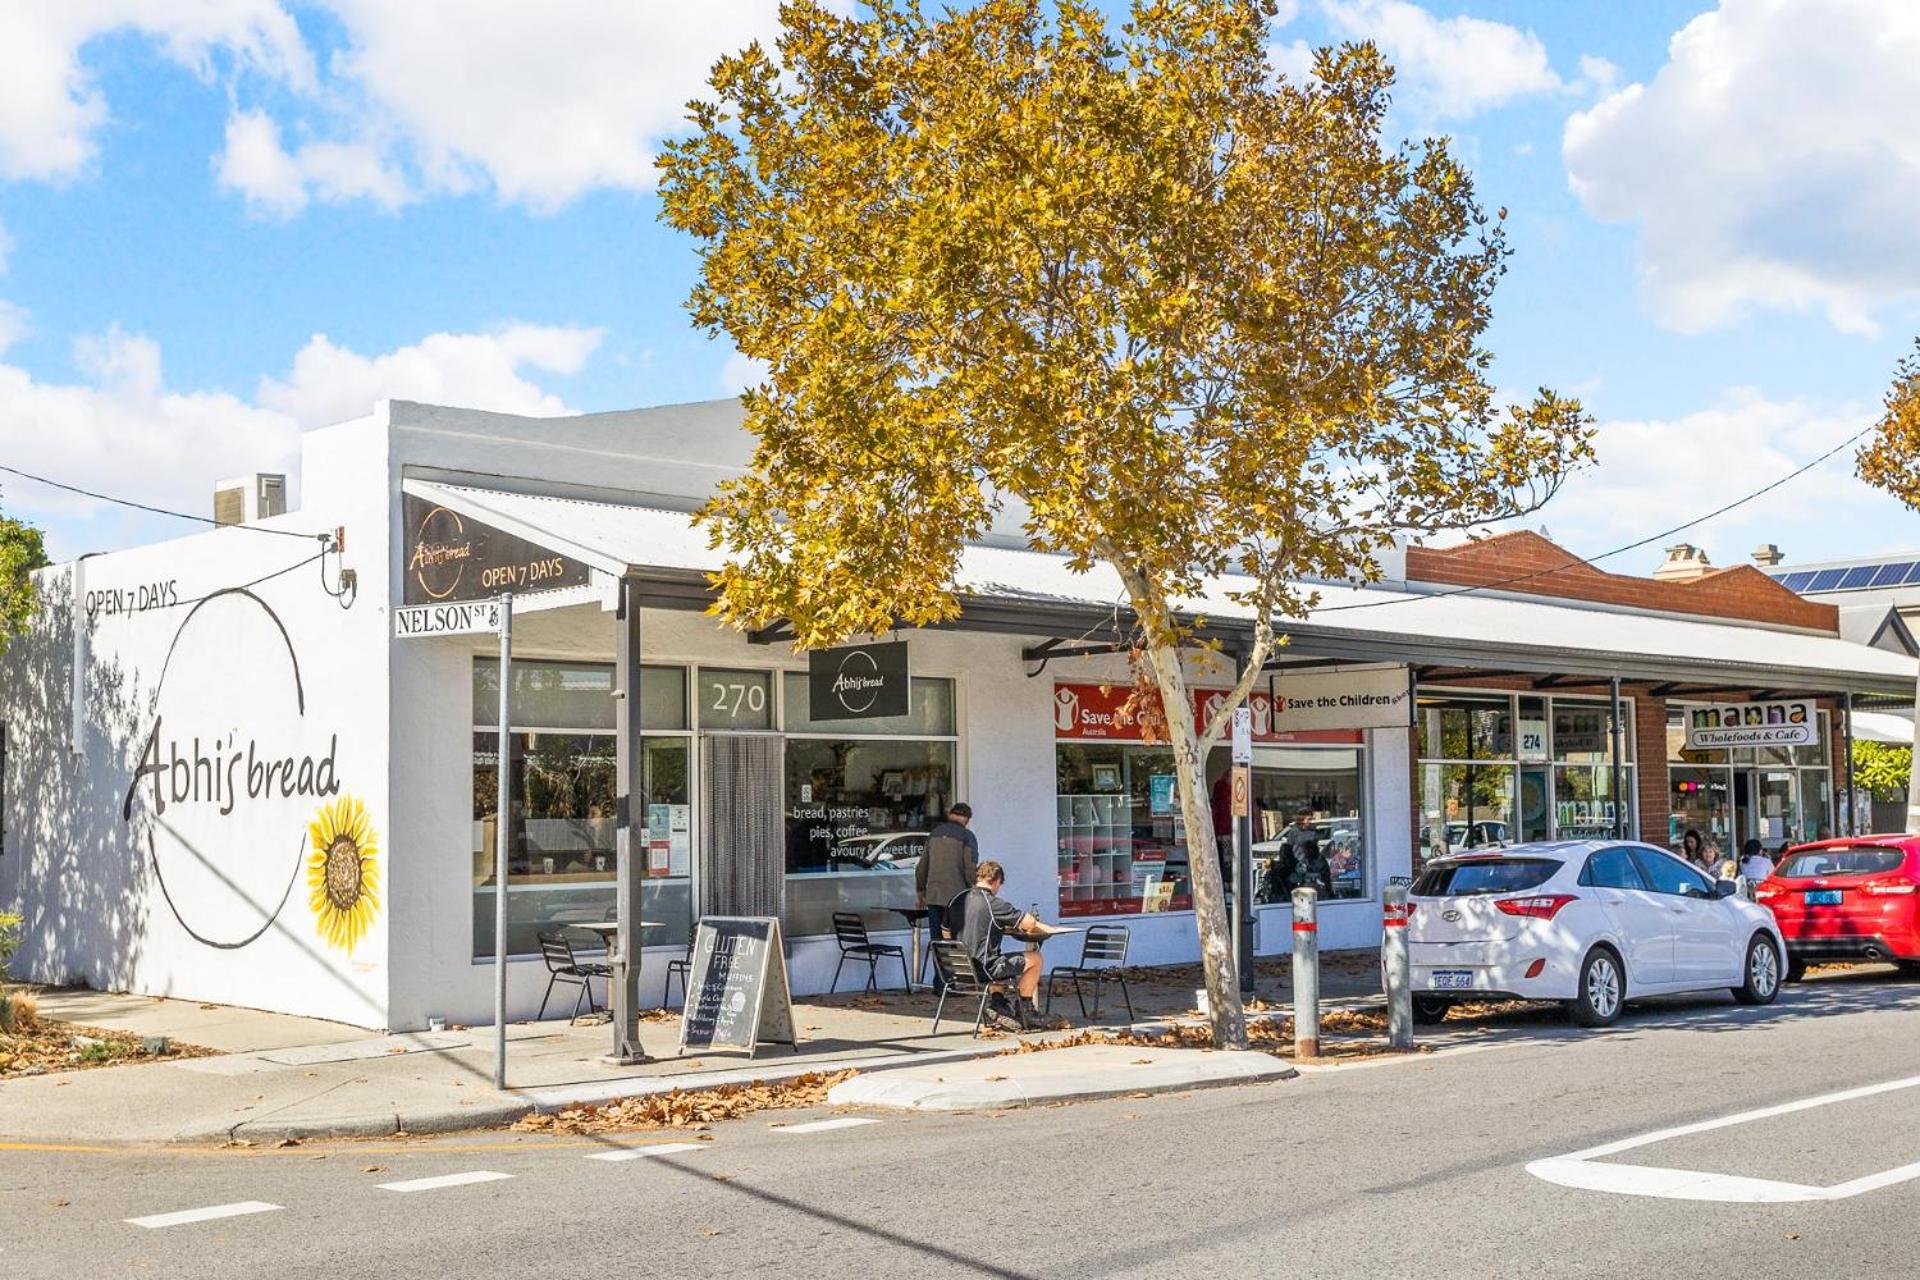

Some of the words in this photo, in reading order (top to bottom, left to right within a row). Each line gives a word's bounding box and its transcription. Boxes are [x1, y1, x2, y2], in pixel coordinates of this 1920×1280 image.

[482, 565, 517, 588] OPEN
[519, 567, 527, 586] 7
[530, 557, 563, 581] DAYS
[85, 589, 123, 616] OPEN
[127, 592, 135, 619] 7
[138, 579, 177, 611] DAYS
[398, 606, 473, 634] NELSON
[474, 604, 487, 617] ST
[862, 675, 884, 688] bread
[712, 683, 765, 717] 270
[1288, 698, 1314, 709] Save
[1317, 696, 1337, 707] the
[1339, 694, 1390, 707] Children
[1081, 708, 1110, 725] Save
[1691, 703, 1808, 729] manna
[1523, 734, 1541, 750] 274
[1700, 731, 1761, 744] Wholefoods
[1763, 731, 1772, 741] &
[247, 733, 340, 798] bread
[793, 805, 827, 820] bread,
[810, 825, 834, 841] pies,
[880, 843, 908, 855] weet
[705, 934, 757, 957] GLUTEN
[714, 954, 740, 969] FREE
